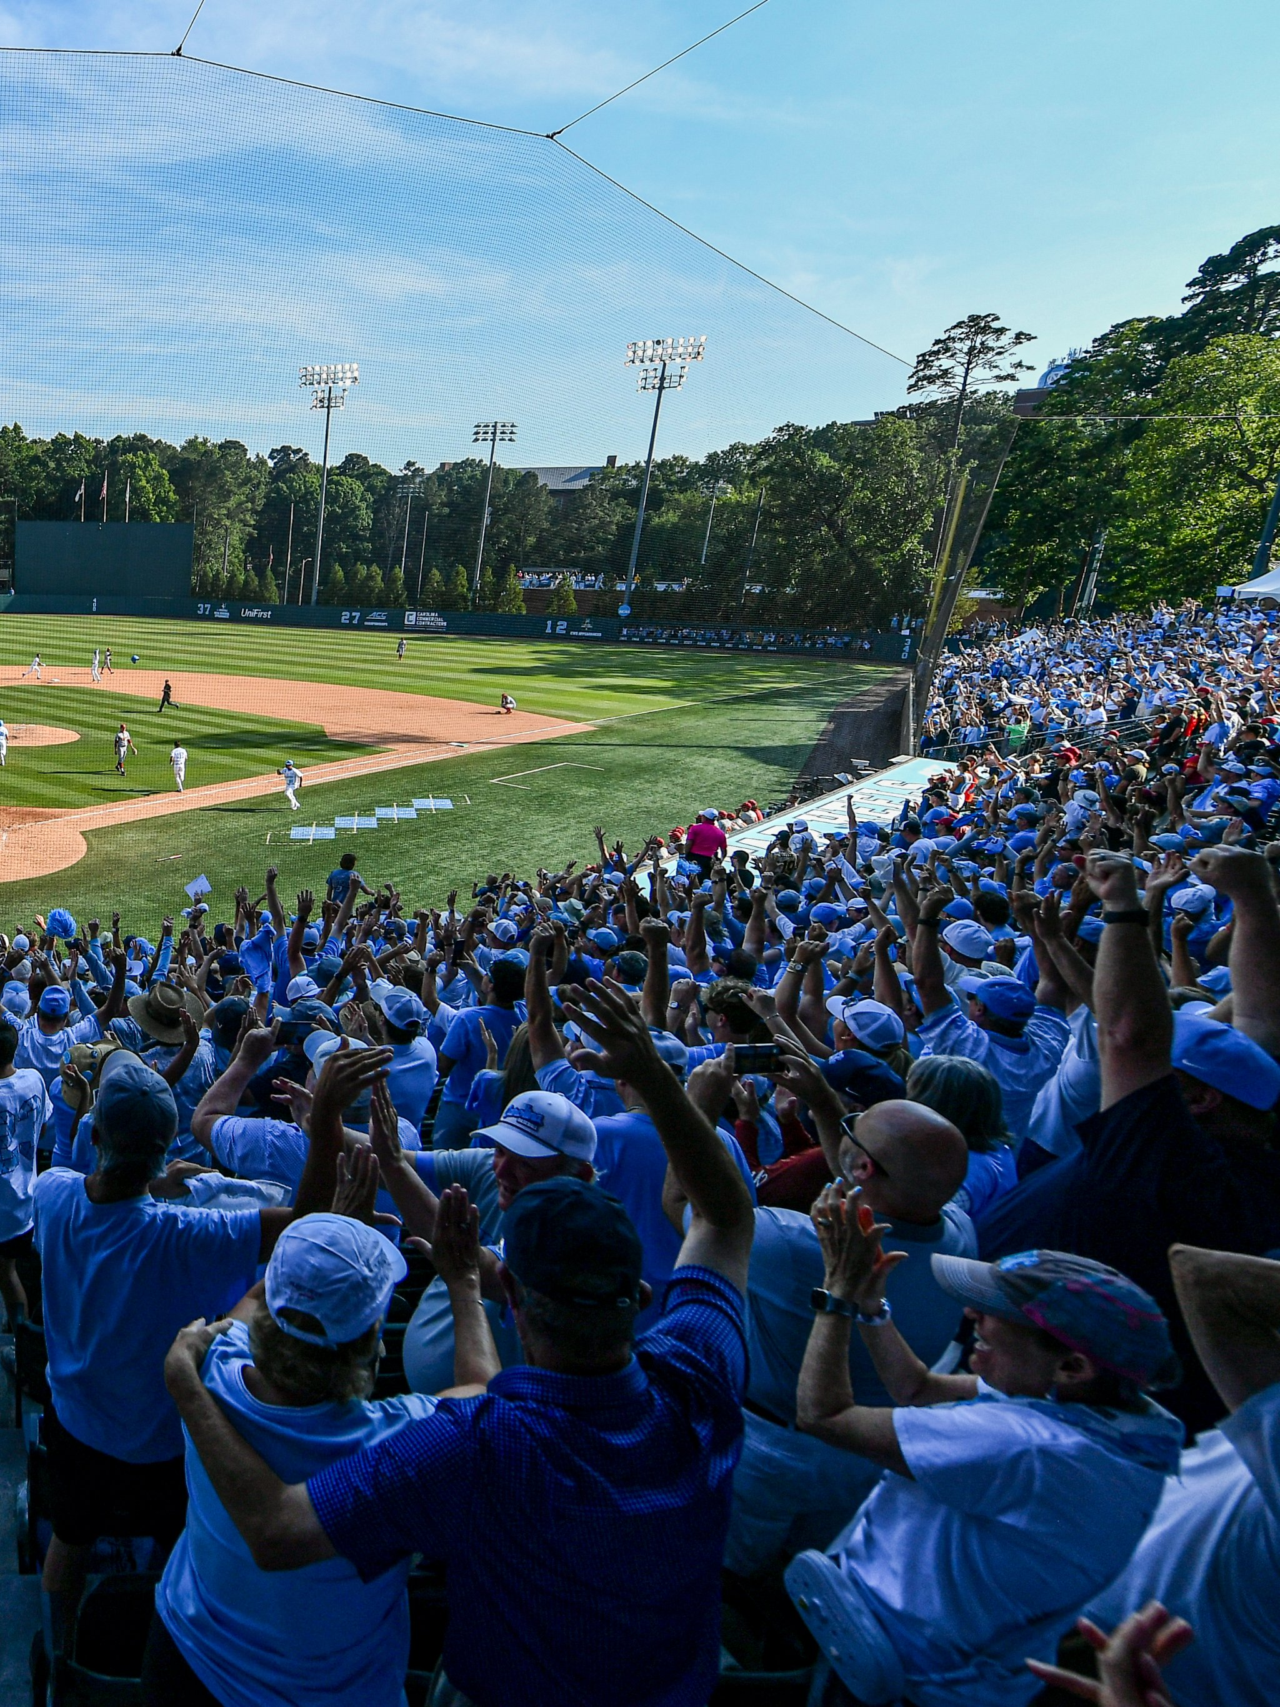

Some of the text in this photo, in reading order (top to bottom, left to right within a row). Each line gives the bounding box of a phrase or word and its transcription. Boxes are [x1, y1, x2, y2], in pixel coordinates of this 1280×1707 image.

[197, 603, 211, 615] 37
[241, 608, 271, 618] UniFirst
[341, 611, 360, 624] 27
[545, 620, 567, 634] 12
[901, 639, 911, 659] 340
